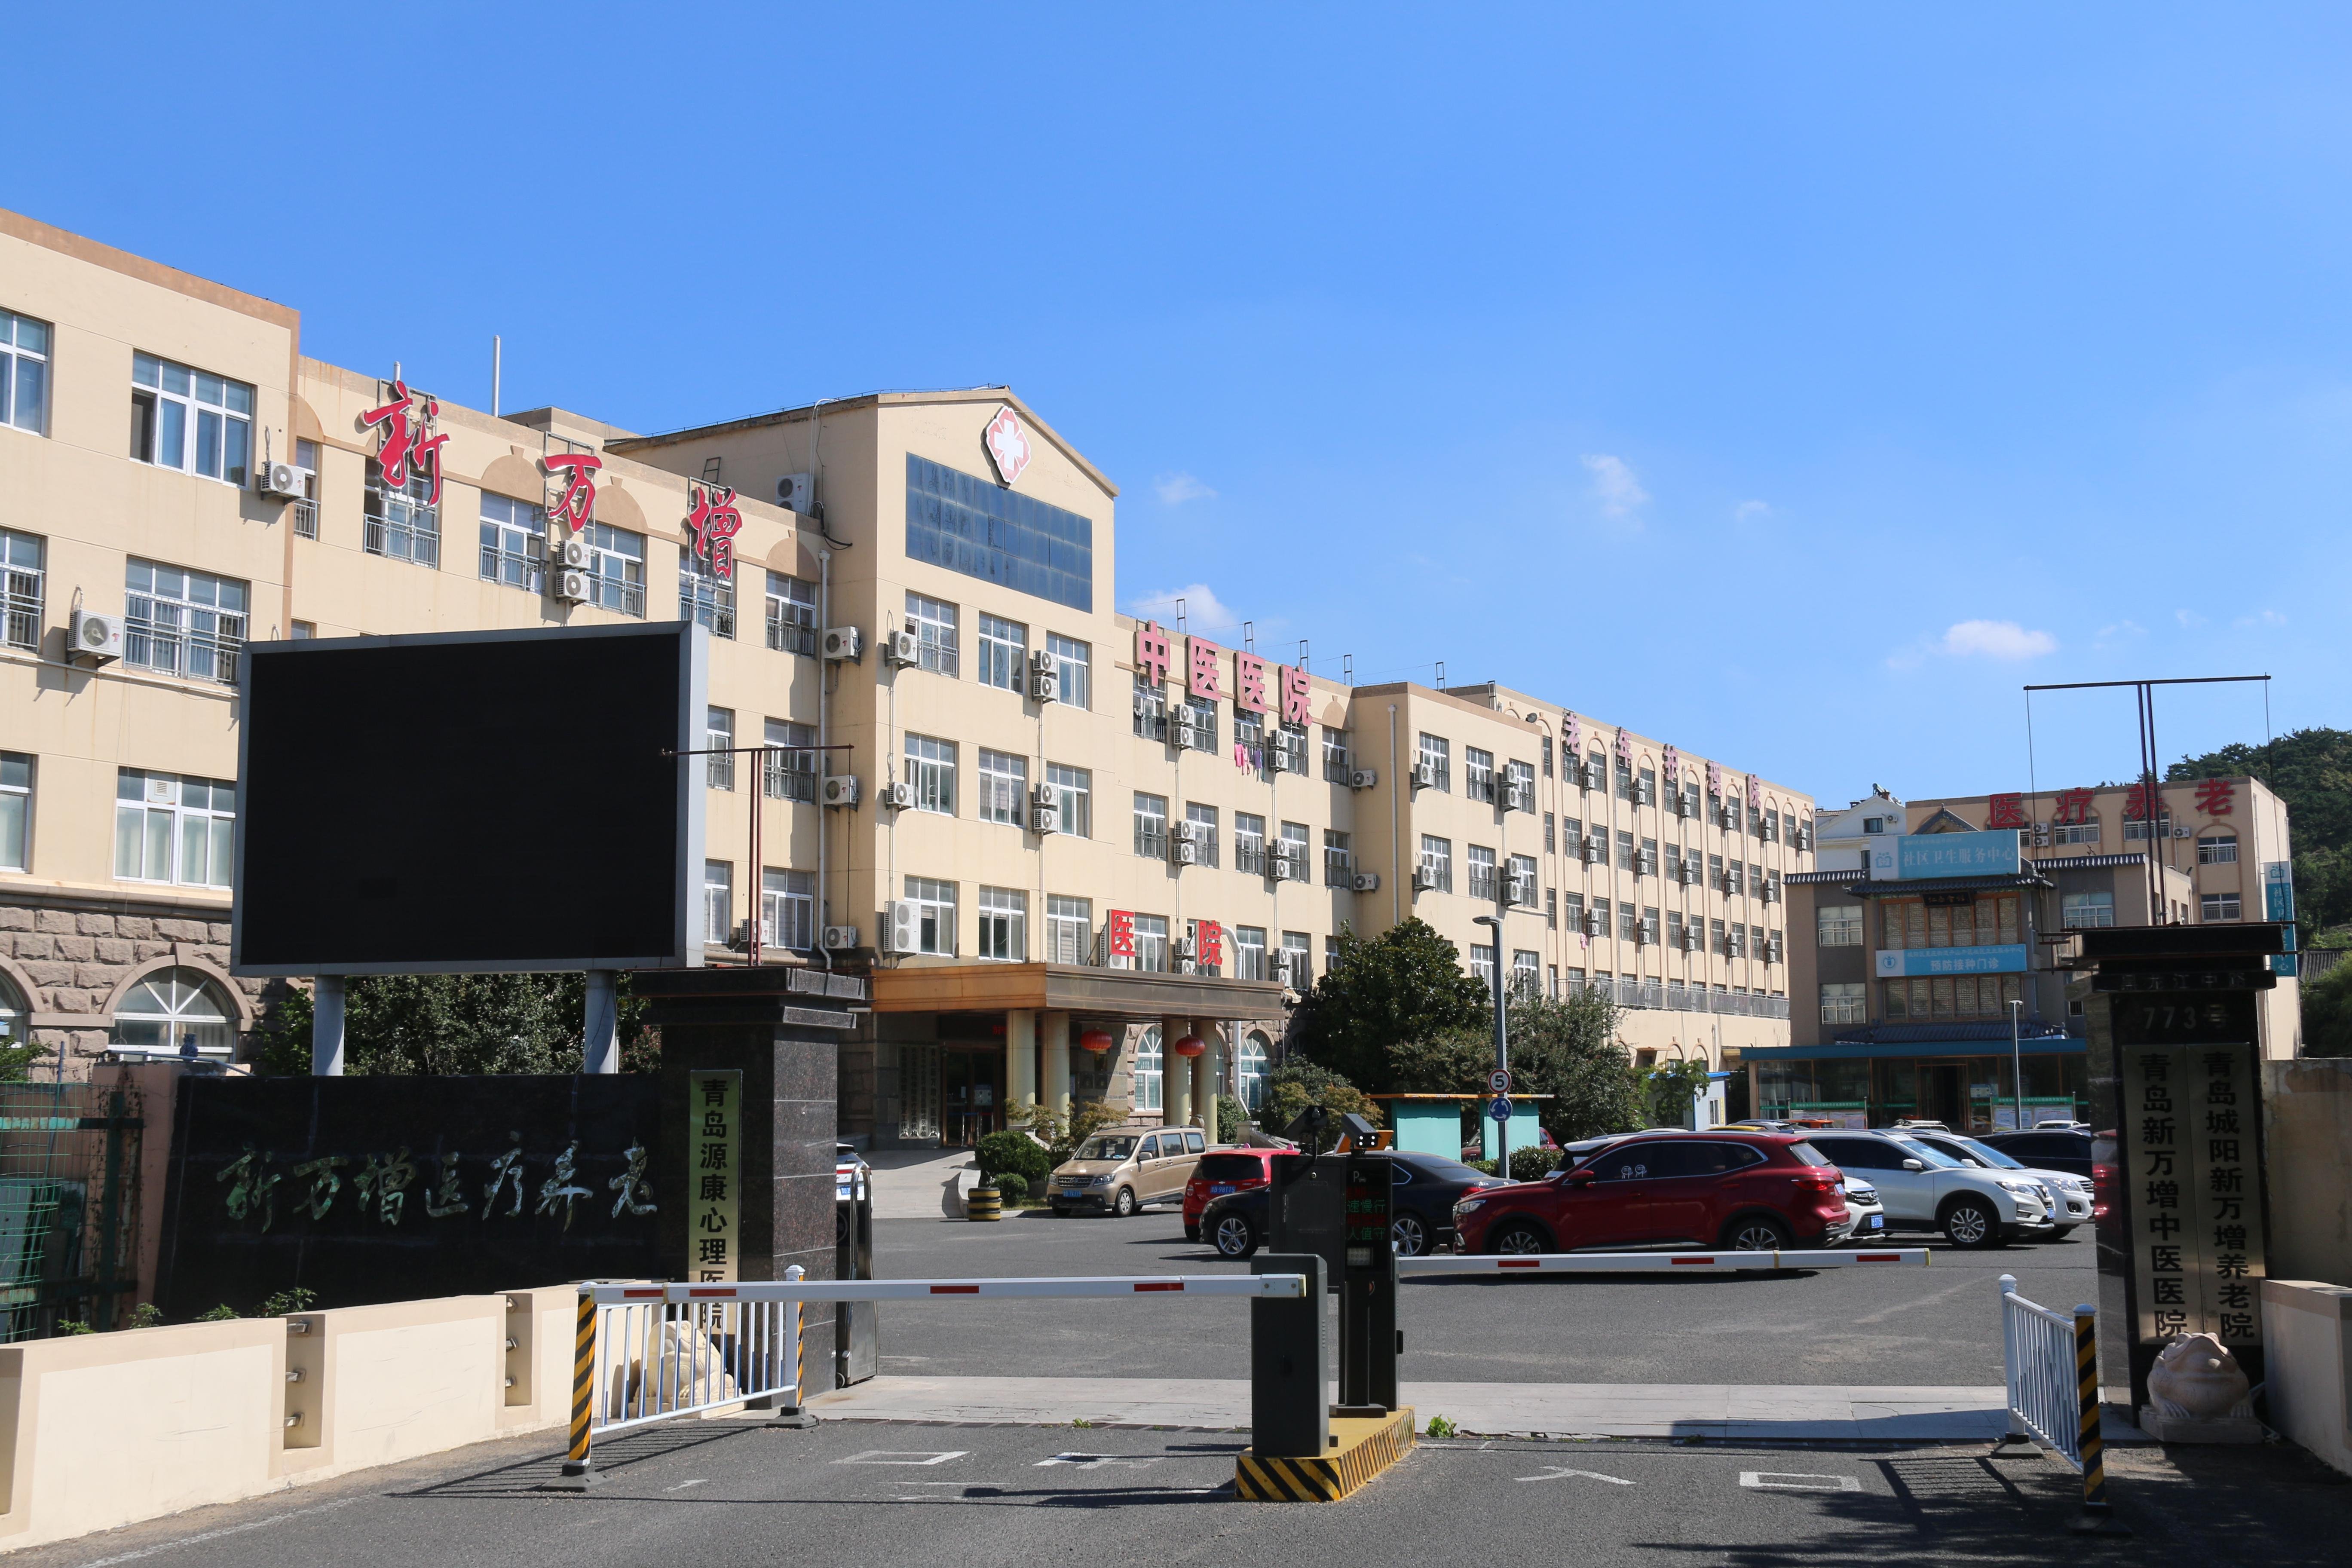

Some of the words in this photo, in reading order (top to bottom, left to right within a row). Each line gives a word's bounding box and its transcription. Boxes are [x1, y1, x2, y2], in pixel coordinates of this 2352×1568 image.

[361, 380, 743, 582] 新万增
[1136, 620, 1312, 727] 中医医院
[1564, 712, 1761, 808] 老年护理院
[1989, 778, 2234, 829] 医疗养老
[1904, 846, 2015, 867] 社区卫生服务中心
[1108, 909, 1222, 966] 医院
[1931, 958, 1999, 971] 预防接种门诊
[1495, 1075, 1504, 1088] 5
[216, 1131, 657, 1233] 新万增医疗养老
[1353, 1171, 1360, 1183] P
[2138, 1053, 2188, 1338] 青岛新万增中医医院
[2202, 1052, 2255, 1338] 青岛城阳新万增养老院
[1345, 1199, 1385, 1213] 速慢行
[1346, 1226, 1386, 1240] 人值守
